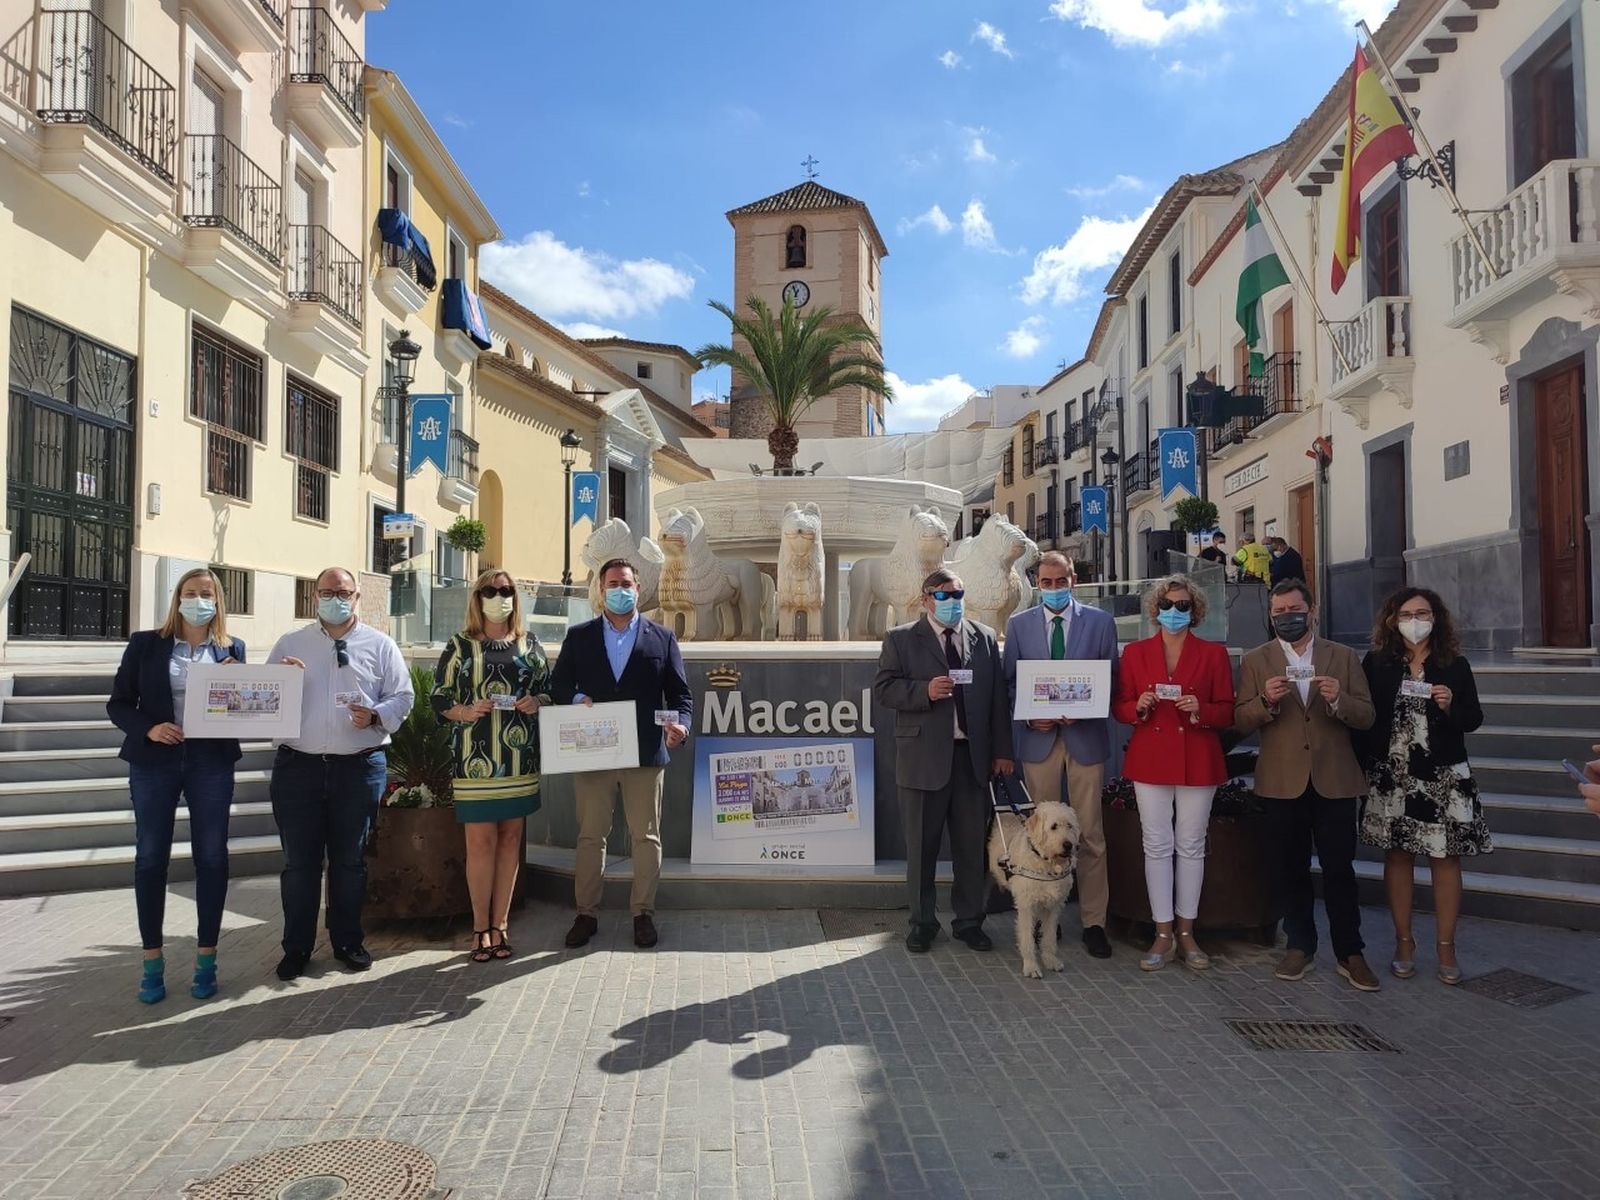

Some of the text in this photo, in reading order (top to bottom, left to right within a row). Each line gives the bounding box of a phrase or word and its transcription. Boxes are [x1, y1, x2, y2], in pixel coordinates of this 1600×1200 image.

[702, 687, 876, 735] Macael
[727, 813, 751, 821] ONCE
[771, 850, 806, 860] ONCE
